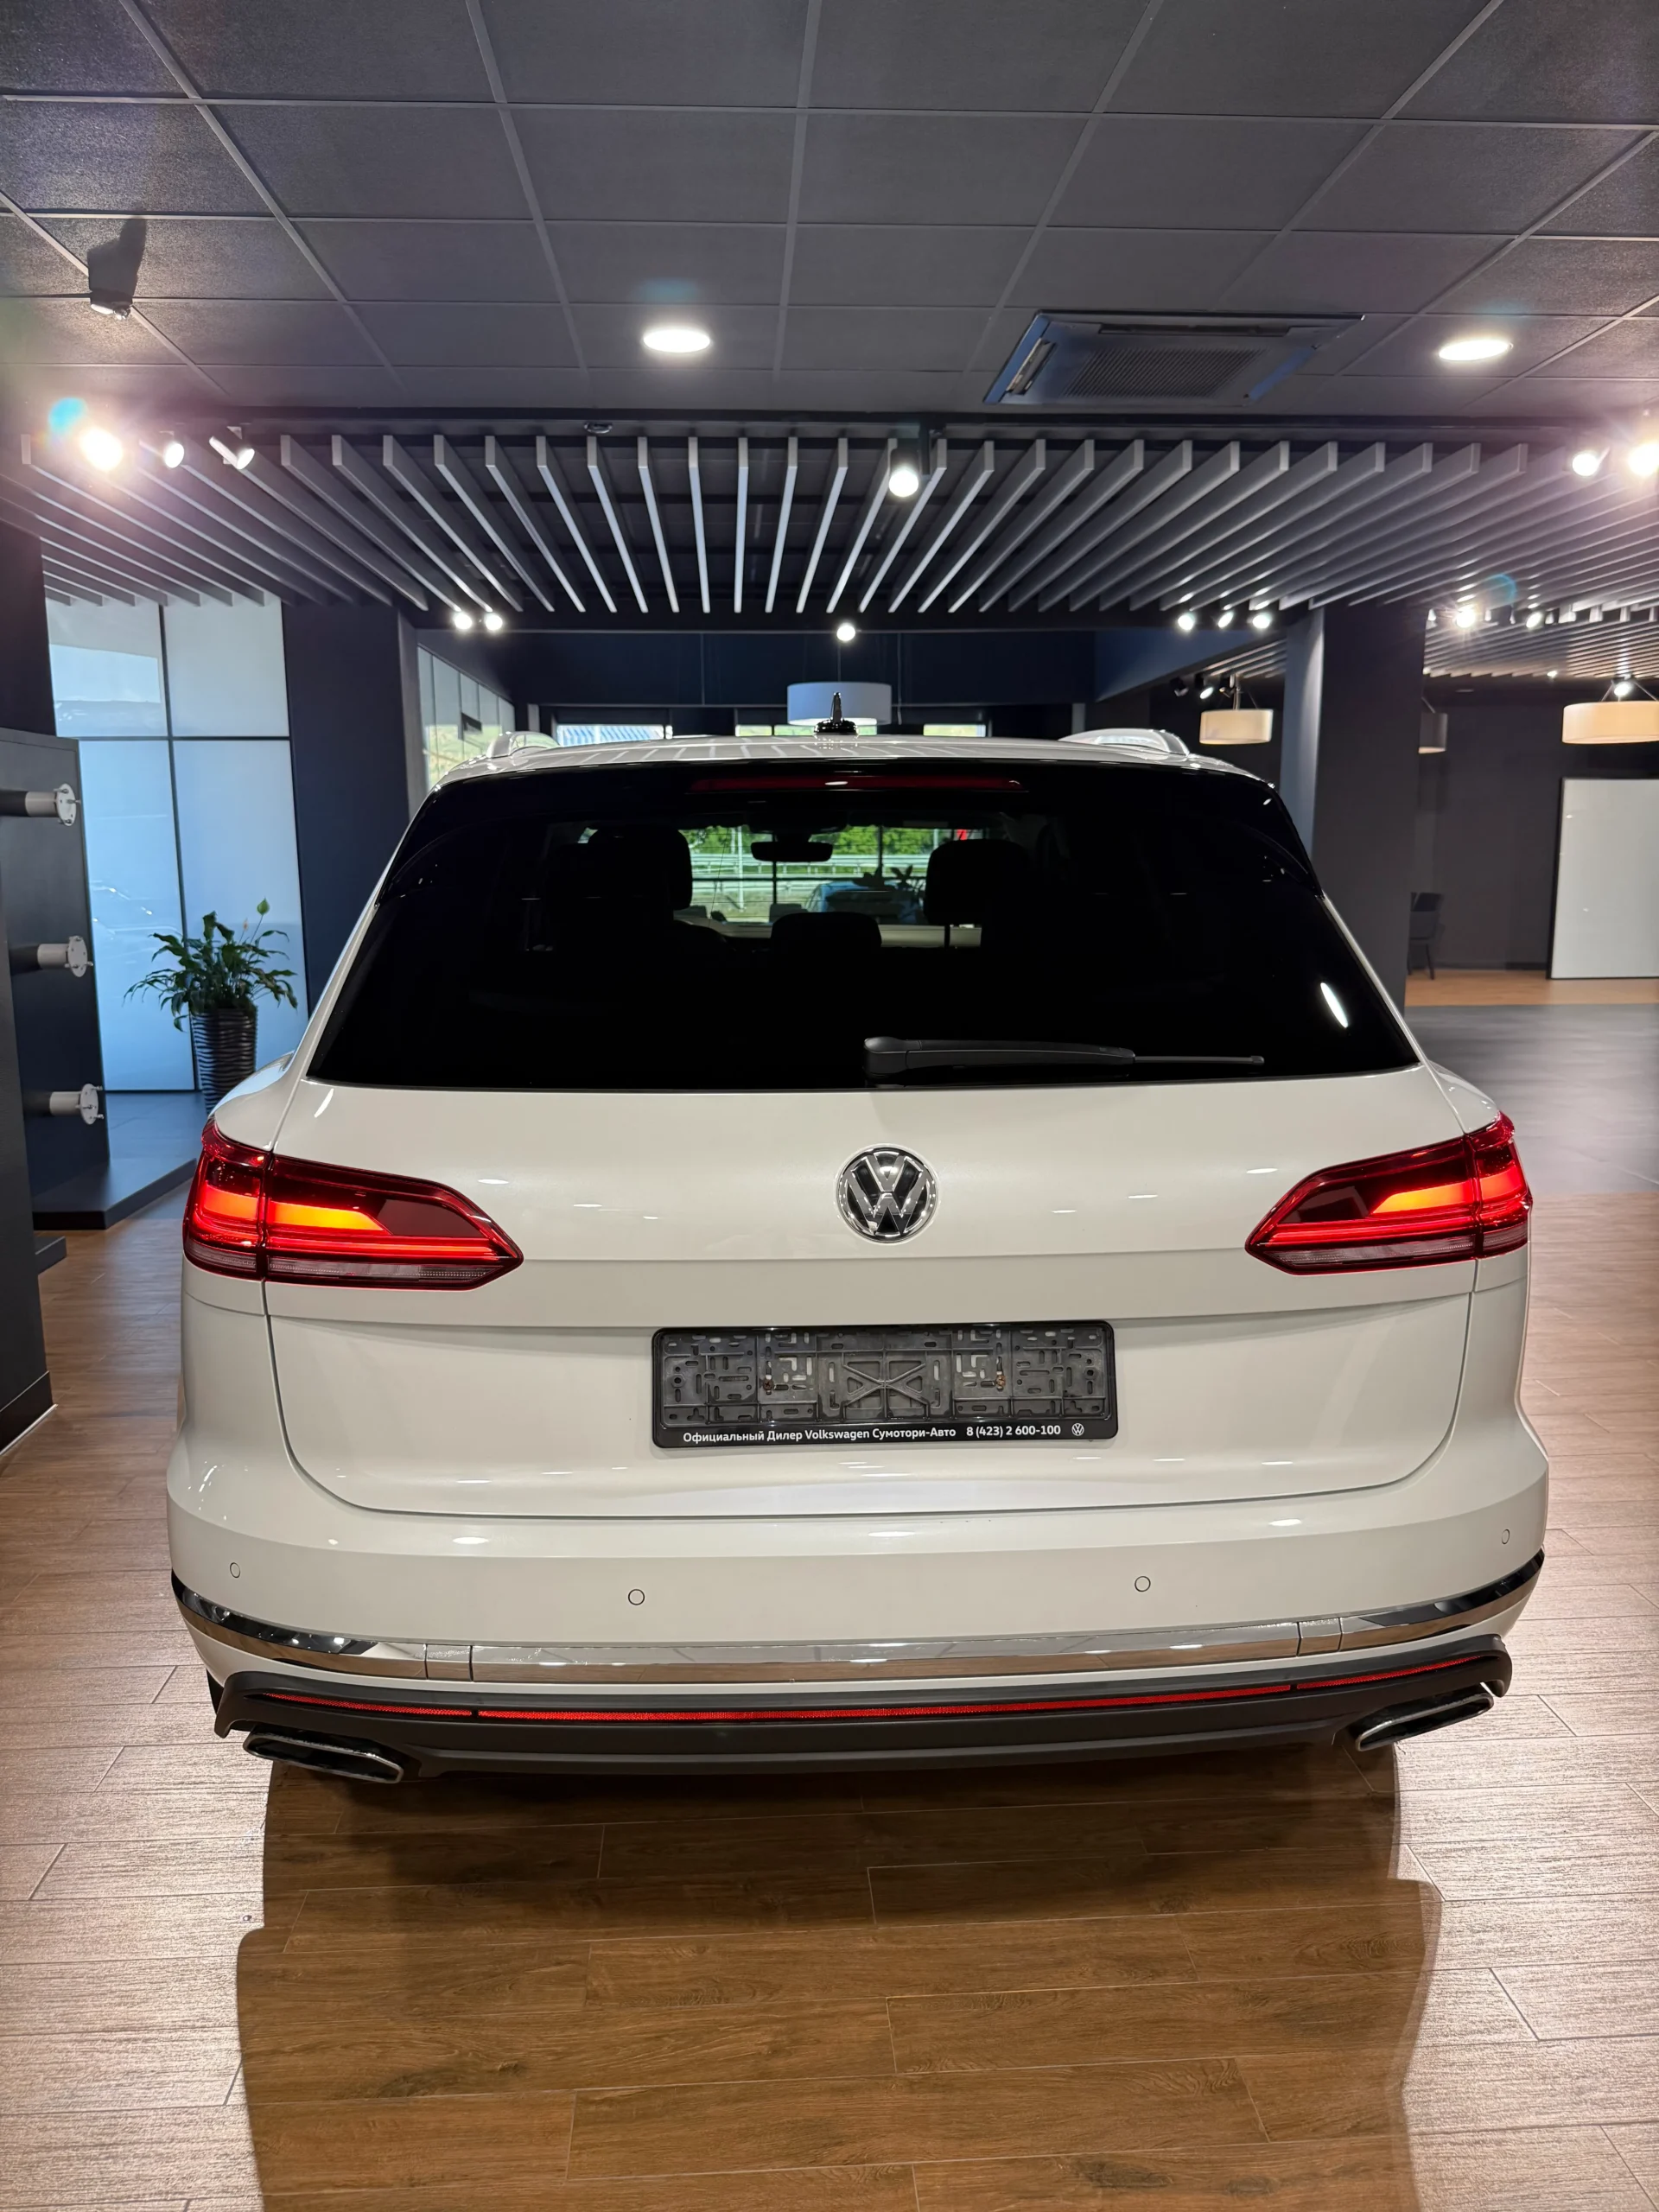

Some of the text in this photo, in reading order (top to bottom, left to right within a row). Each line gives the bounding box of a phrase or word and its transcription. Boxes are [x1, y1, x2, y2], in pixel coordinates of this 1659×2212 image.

[838, 1147, 936, 1243] VW
[683, 1425, 1061, 1444] Официальный Дилер Volkswagen Сумотори-Авто 8 (423) 2 600-100
